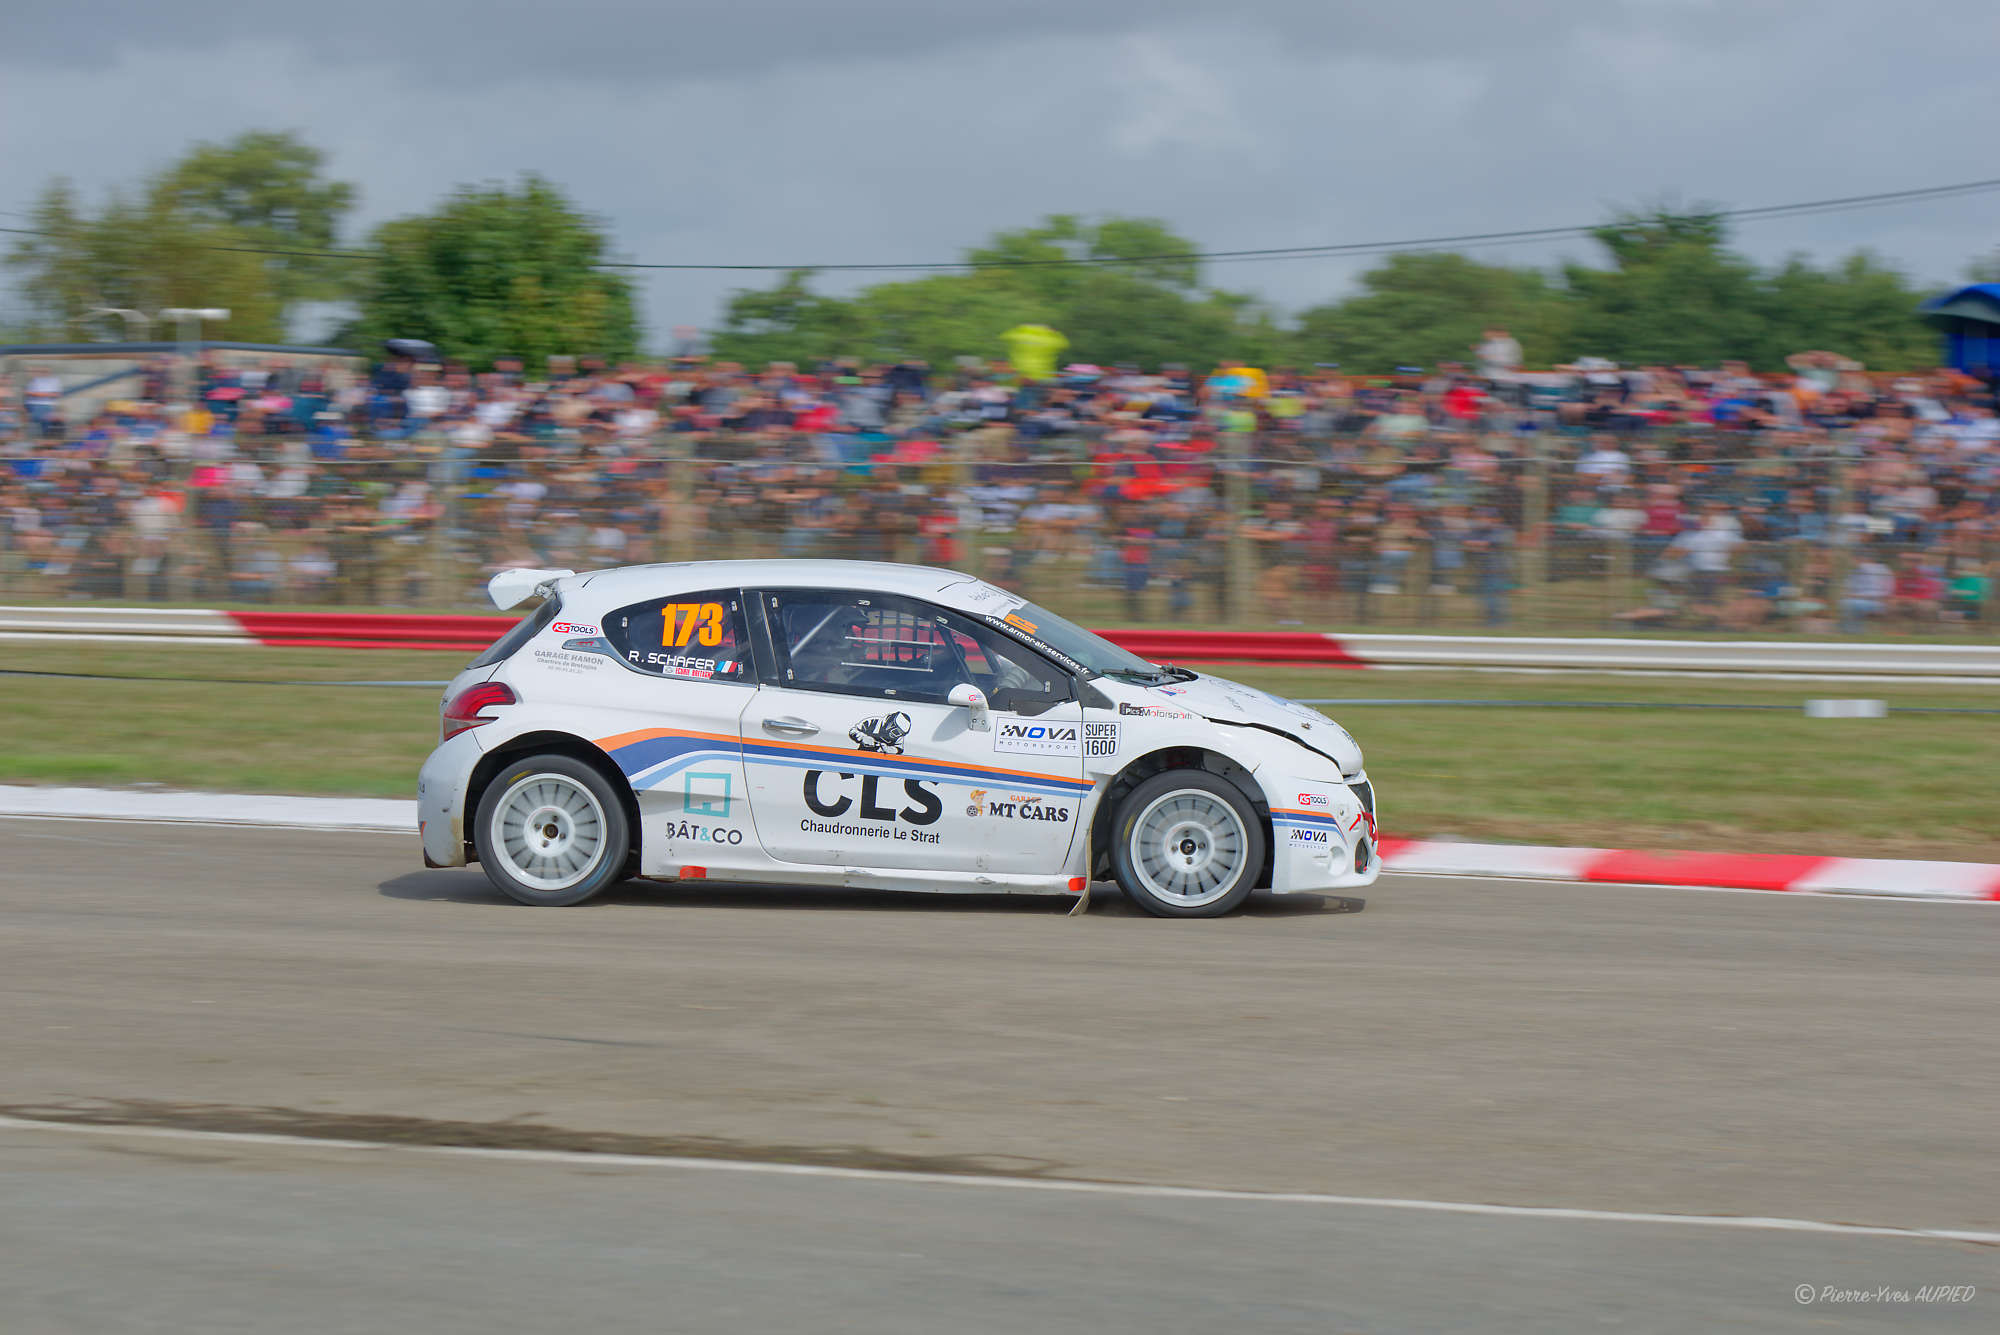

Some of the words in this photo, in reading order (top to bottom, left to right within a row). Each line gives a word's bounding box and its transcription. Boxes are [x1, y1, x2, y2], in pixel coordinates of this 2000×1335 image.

[570, 625, 594, 634] TOOLS
[661, 602, 723, 647] 173
[985, 615, 1090, 675] www.armor-air-services.fr
[535, 650, 569, 661] GARAGE
[571, 654, 604, 665] HAMON
[647, 653, 716, 671] SCHAFER
[1001, 725, 1076, 741] NOVA
[1085, 723, 1117, 737] SUPER
[999, 740, 1078, 750] MOTORSPORT
[1085, 740, 1116, 756] 1600
[803, 770, 943, 826] CLS
[989, 802, 1016, 818] MT
[1019, 803, 1069, 823] CARS
[800, 819, 890, 839] Chaudronnerie
[894, 827, 907, 840] Le
[911, 829, 940, 844] Strat
[1291, 828, 1328, 843] NOVA
